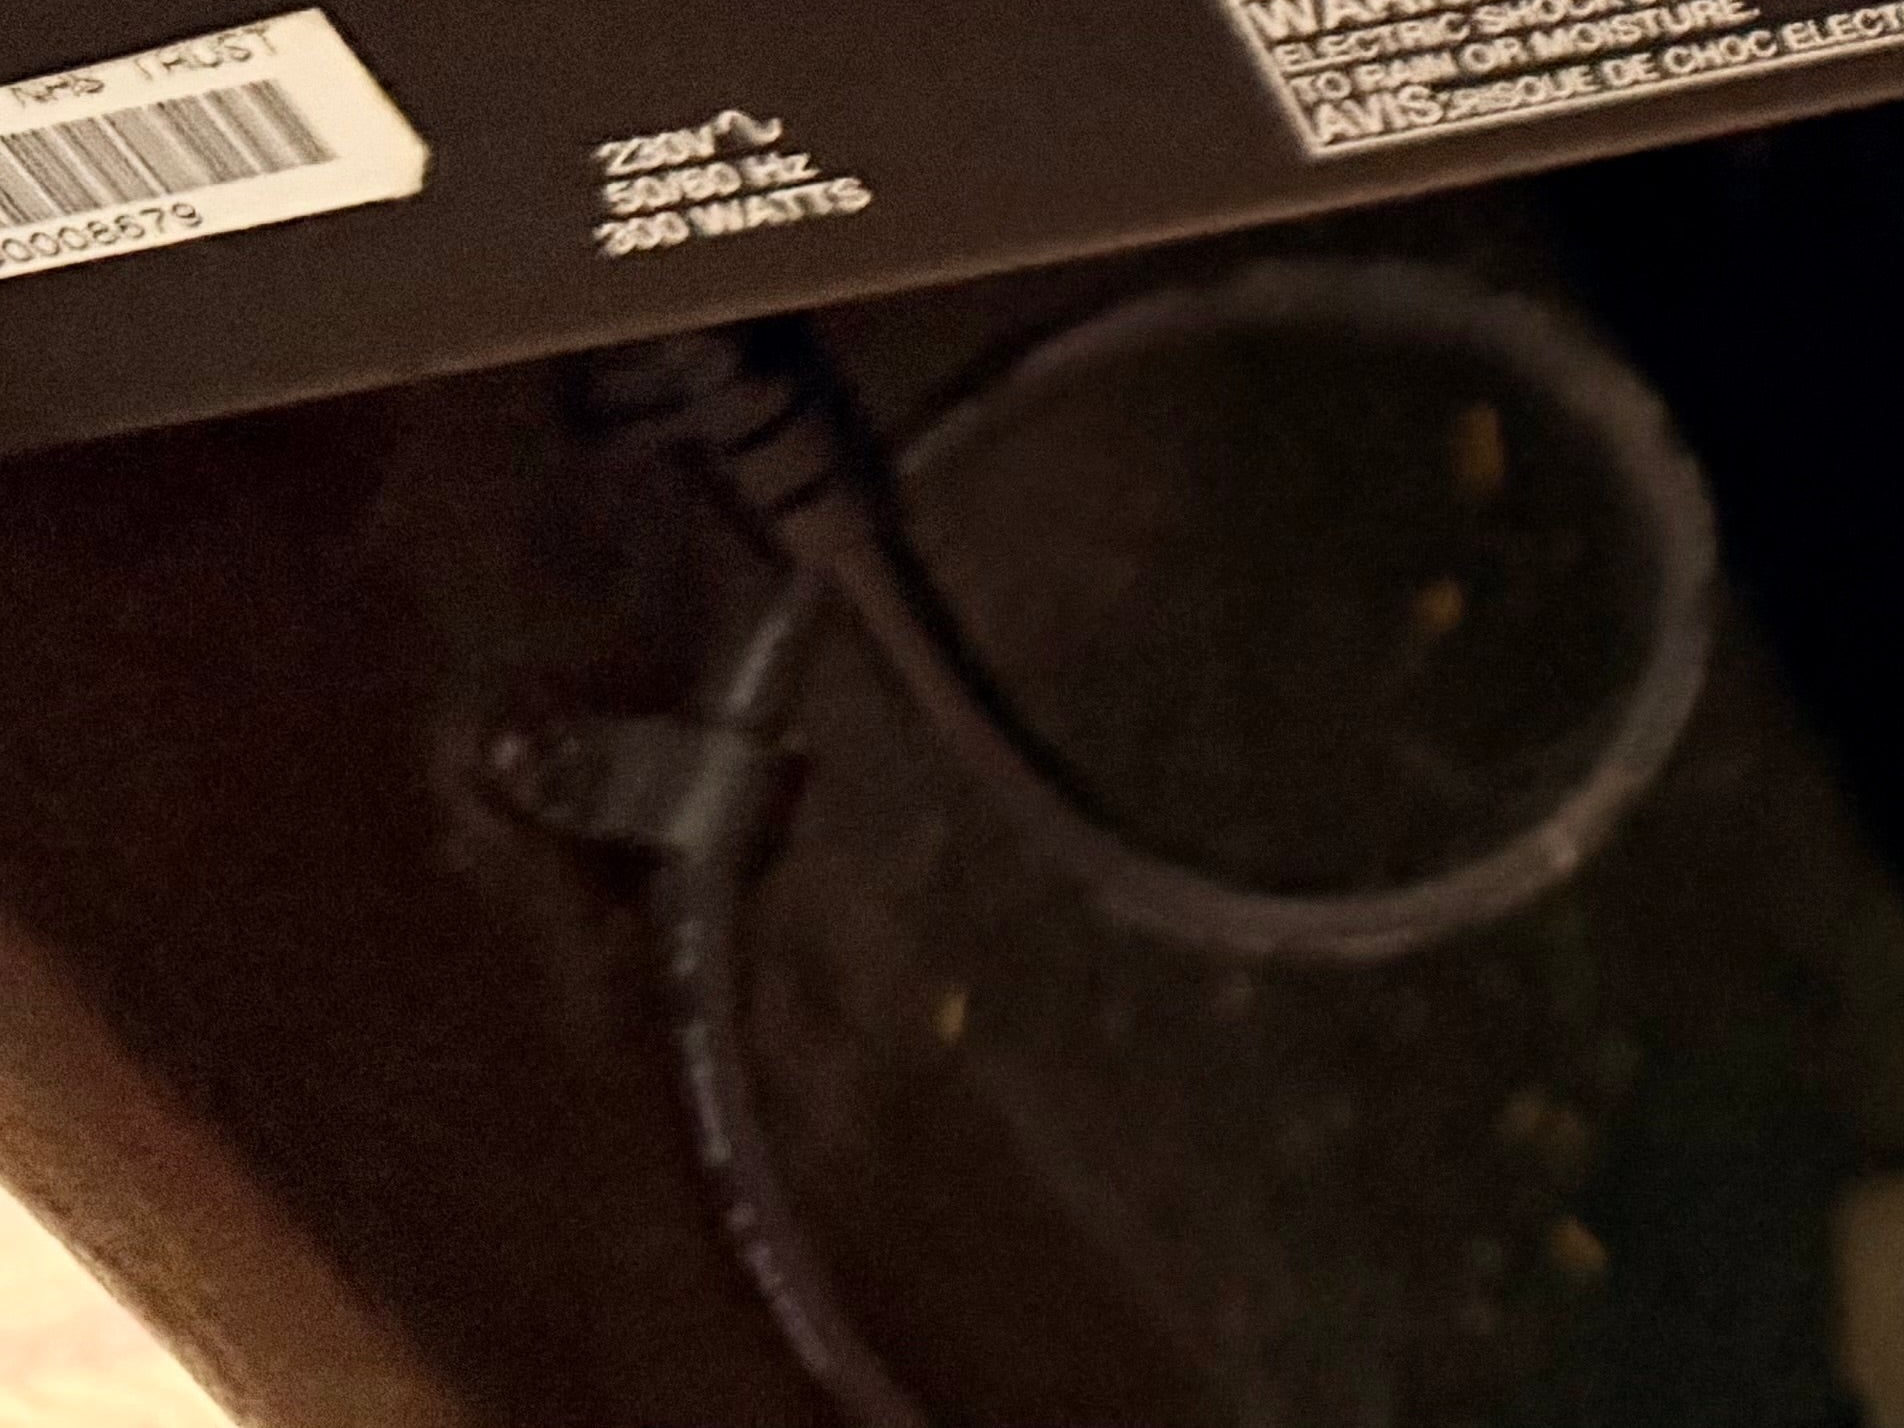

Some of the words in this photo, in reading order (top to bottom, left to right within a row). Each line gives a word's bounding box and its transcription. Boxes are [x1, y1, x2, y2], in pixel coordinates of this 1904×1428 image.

[133, 24, 281, 82] TRUST
[1273, 10, 1472, 72] ELECTRIC
[1288, 73, 1351, 105] TO
[1355, 50, 1459, 94] RAIN
[1460, 36, 1529, 73] OR
[1602, 51, 1660, 87] DE
[1662, 25, 1780, 74] CHOC
[686, 177, 873, 238] WATTS
